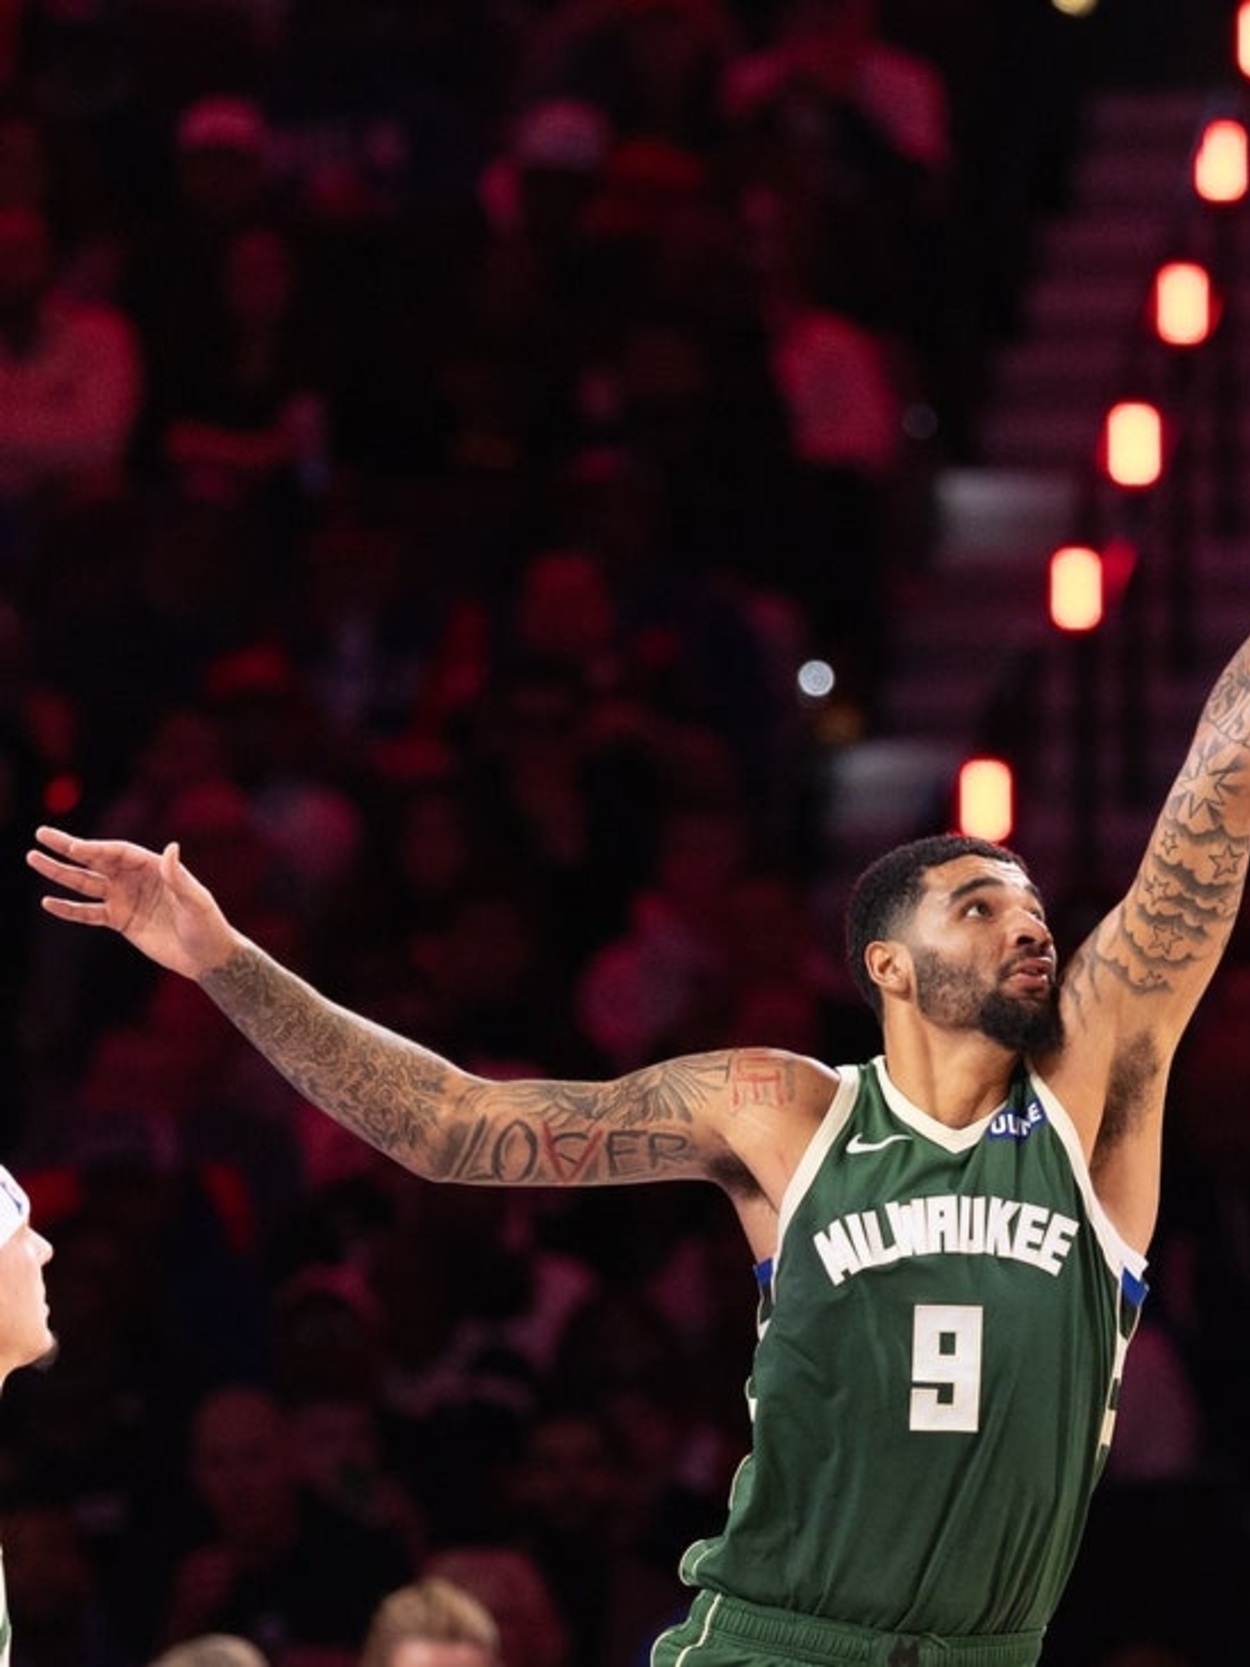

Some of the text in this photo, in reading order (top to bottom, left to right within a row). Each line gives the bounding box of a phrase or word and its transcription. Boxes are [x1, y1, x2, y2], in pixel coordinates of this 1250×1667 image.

[991, 1102, 1042, 1137] ULE
[812, 1194, 1079, 1286] MILWAUKEE
[909, 1304, 983, 1432] 9
